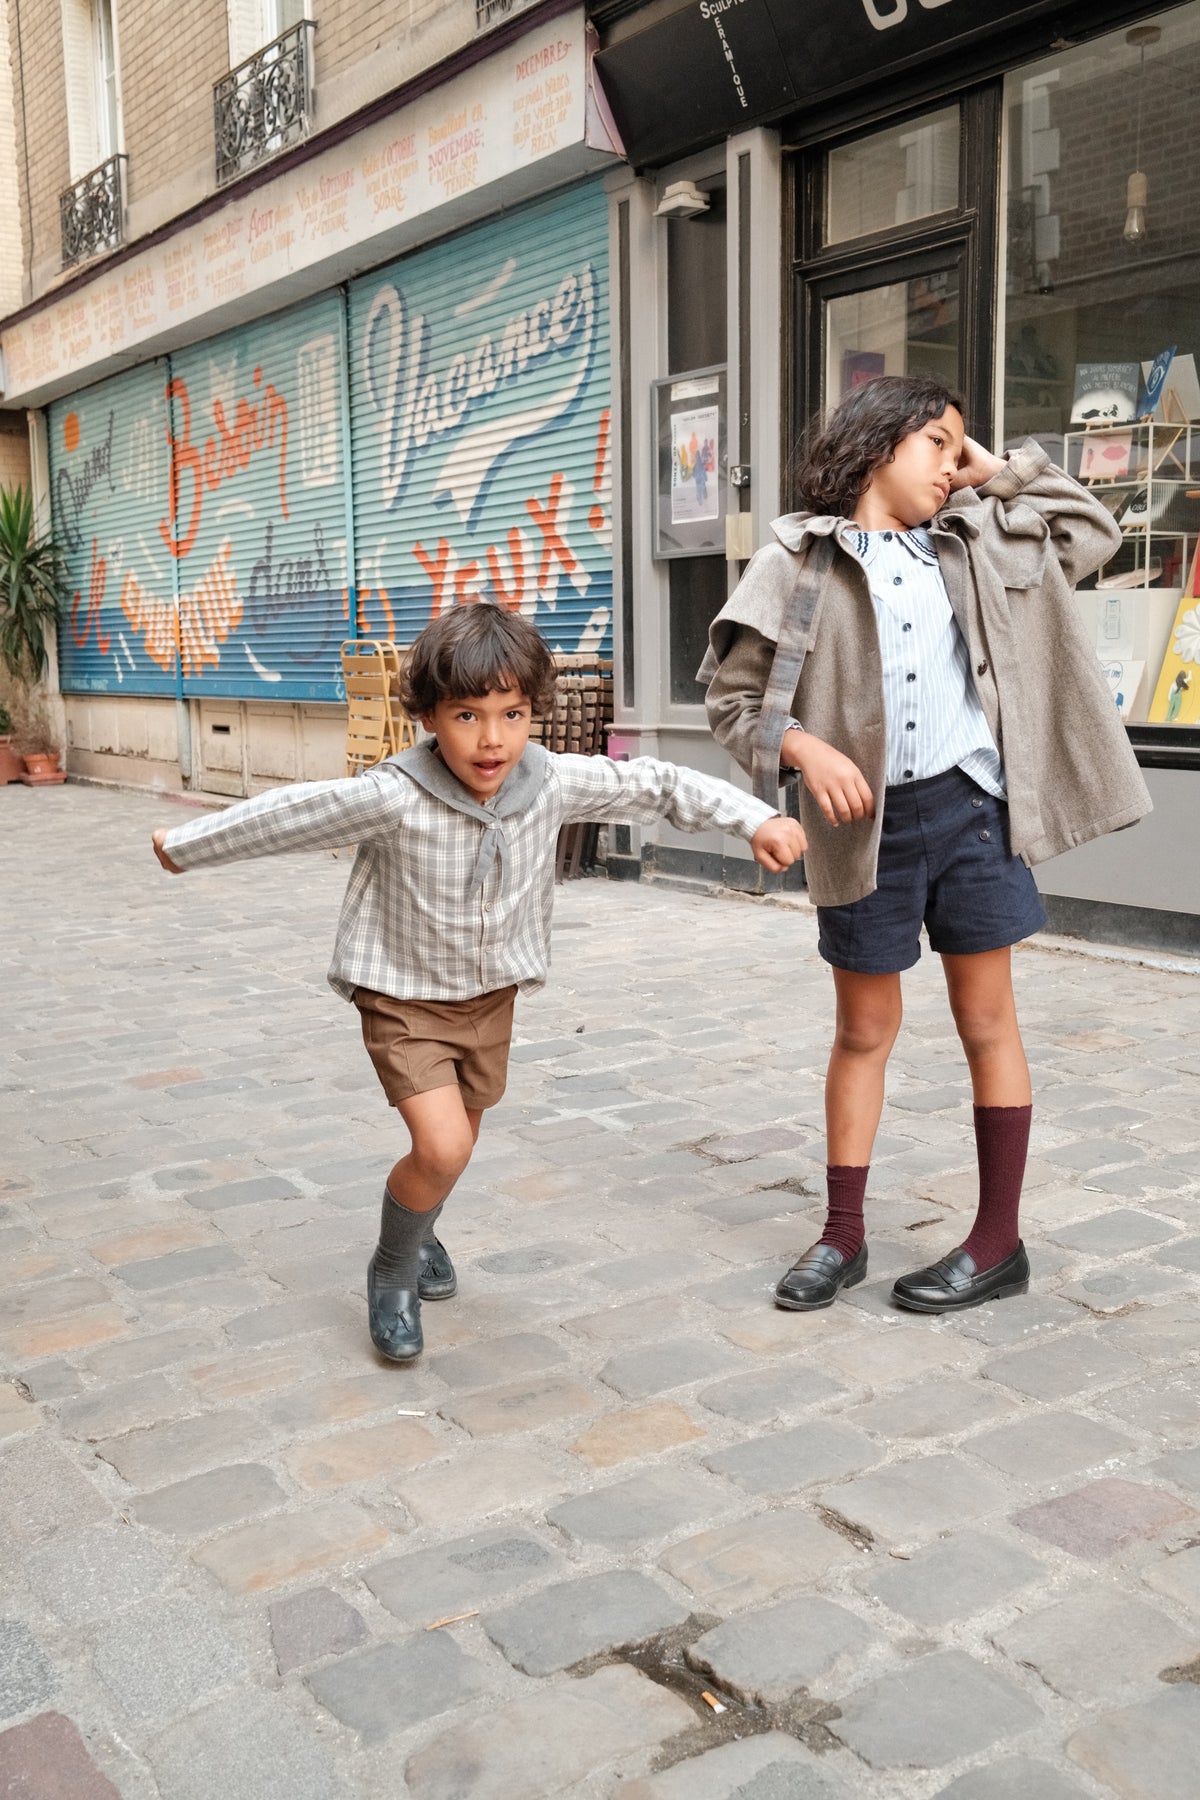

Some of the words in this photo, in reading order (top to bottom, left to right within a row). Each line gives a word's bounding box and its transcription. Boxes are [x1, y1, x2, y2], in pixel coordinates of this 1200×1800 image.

[159, 364, 290, 558] Besoin
[362, 262, 600, 532] Vacances
[249, 520, 332, 665] dans
